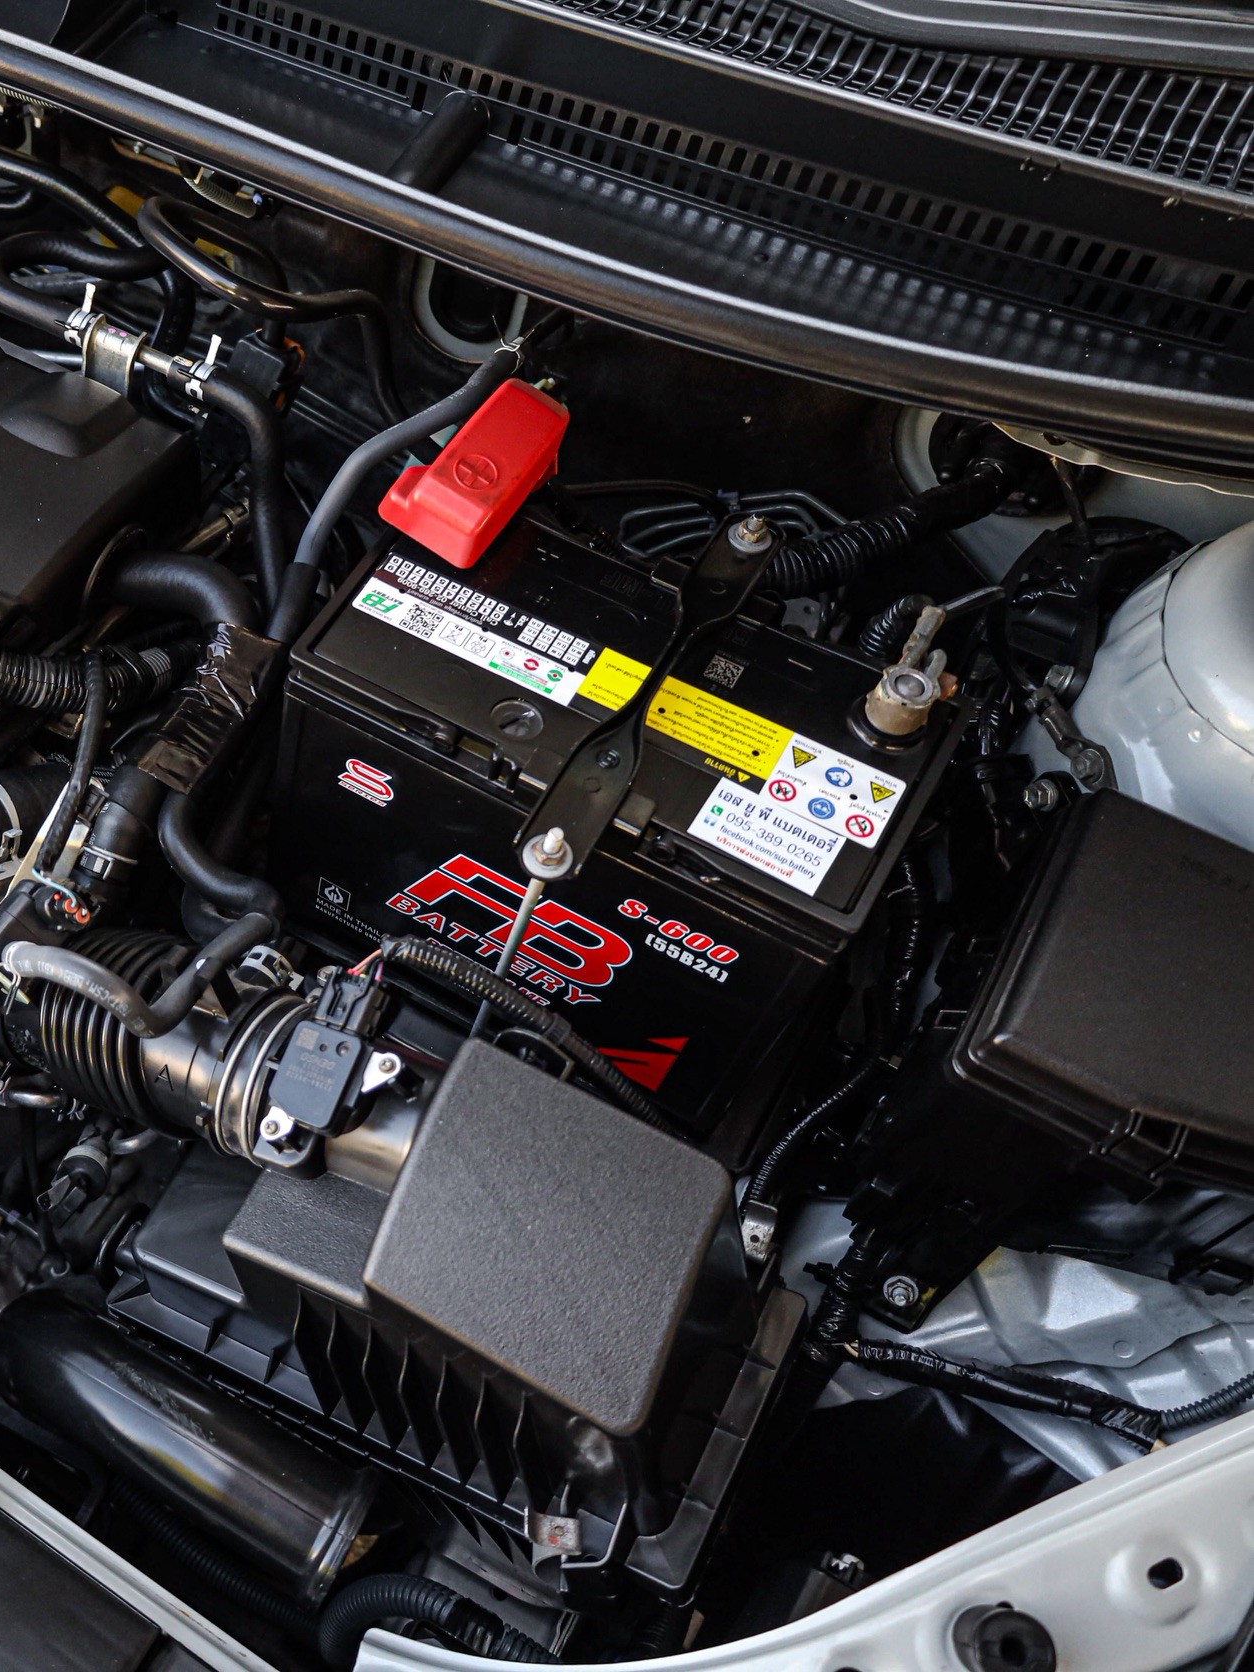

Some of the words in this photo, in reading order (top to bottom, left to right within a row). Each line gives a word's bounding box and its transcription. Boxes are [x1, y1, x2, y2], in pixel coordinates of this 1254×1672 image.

[360, 591, 398, 613] FB
[448, 599, 478, 618] Center
[479, 613, 498, 627] Call
[724, 811, 823, 867] 095-389-0265
[314, 897, 342, 915] MADE
[343, 913, 353, 921] IN
[354, 919, 384, 938] THAIL
[404, 854, 633, 987] FB
[617, 898, 739, 965] S-600
[386, 892, 601, 1005] BATTERY
